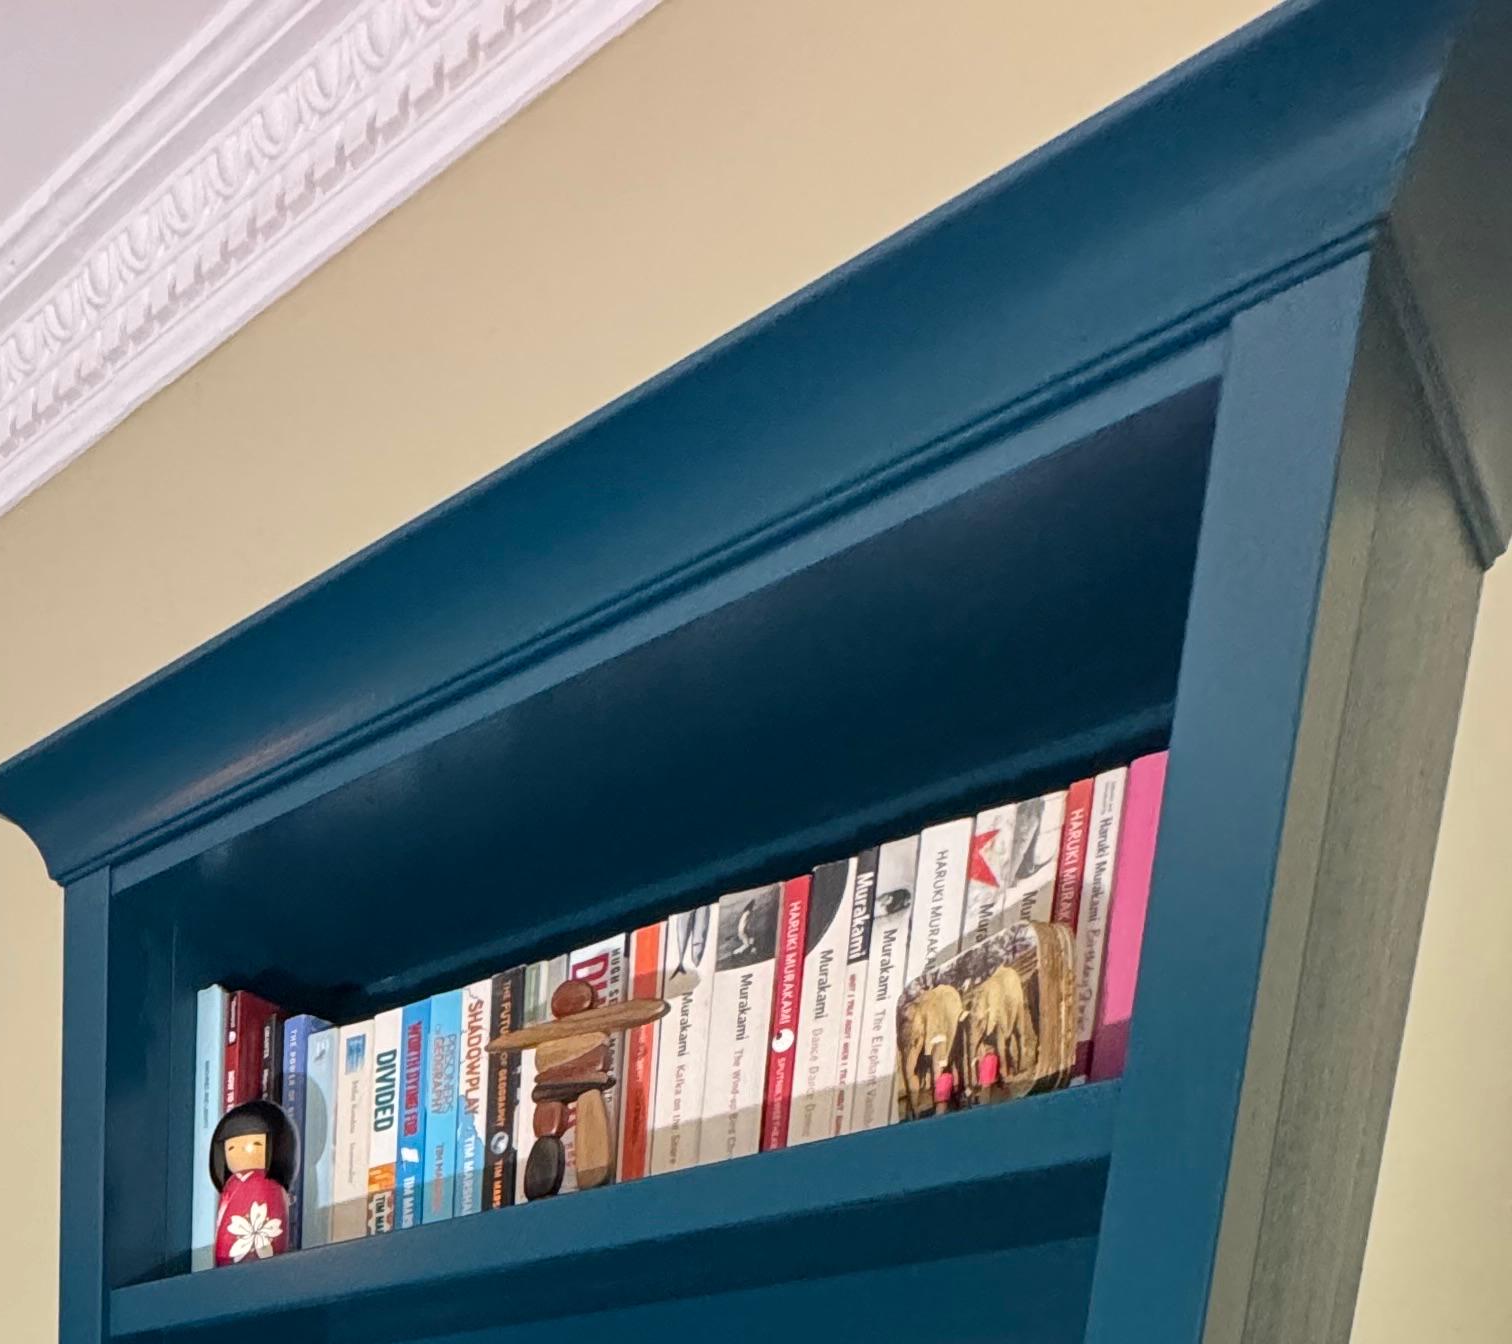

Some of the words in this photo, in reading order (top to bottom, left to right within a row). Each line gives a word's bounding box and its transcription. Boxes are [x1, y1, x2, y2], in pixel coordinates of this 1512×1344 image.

[1063, 808, 1085, 865] HARUKI
[1095, 816, 1114, 858] Haruki
[931, 850, 950, 902] HARUKI
[1087, 861, 1109, 922] Murakami
[785, 900, 803, 952] HARUKI
[848, 872, 875, 960] Murakami
[502, 980, 512, 1000] THE
[778, 955, 799, 1024] MURAKAMI
[814, 950, 834, 1019] Murakami
[876, 929, 898, 1001] Murakami
[677, 992, 694, 1057] Murakami
[735, 973, 753, 1040] Murakami
[873, 1009, 887, 1032] The
[406, 1021, 423, 1068] WORTH
[464, 1000, 485, 1116] SHADOWPLAY
[732, 1049, 745, 1068] The
[808, 1028, 823, 1061] Dance
[374, 1049, 397, 1132] DIVIDED
[405, 1072, 421, 1109] DYING
[442, 1034, 457, 1112] PRISONERS
[495, 1069, 508, 1127] GEOGRAPHY
[674, 1064, 686, 1095] Kafka
[404, 1113, 420, 1136] FOR
[464, 1136, 476, 1158] TIM
[403, 1177, 415, 1194] TIM
